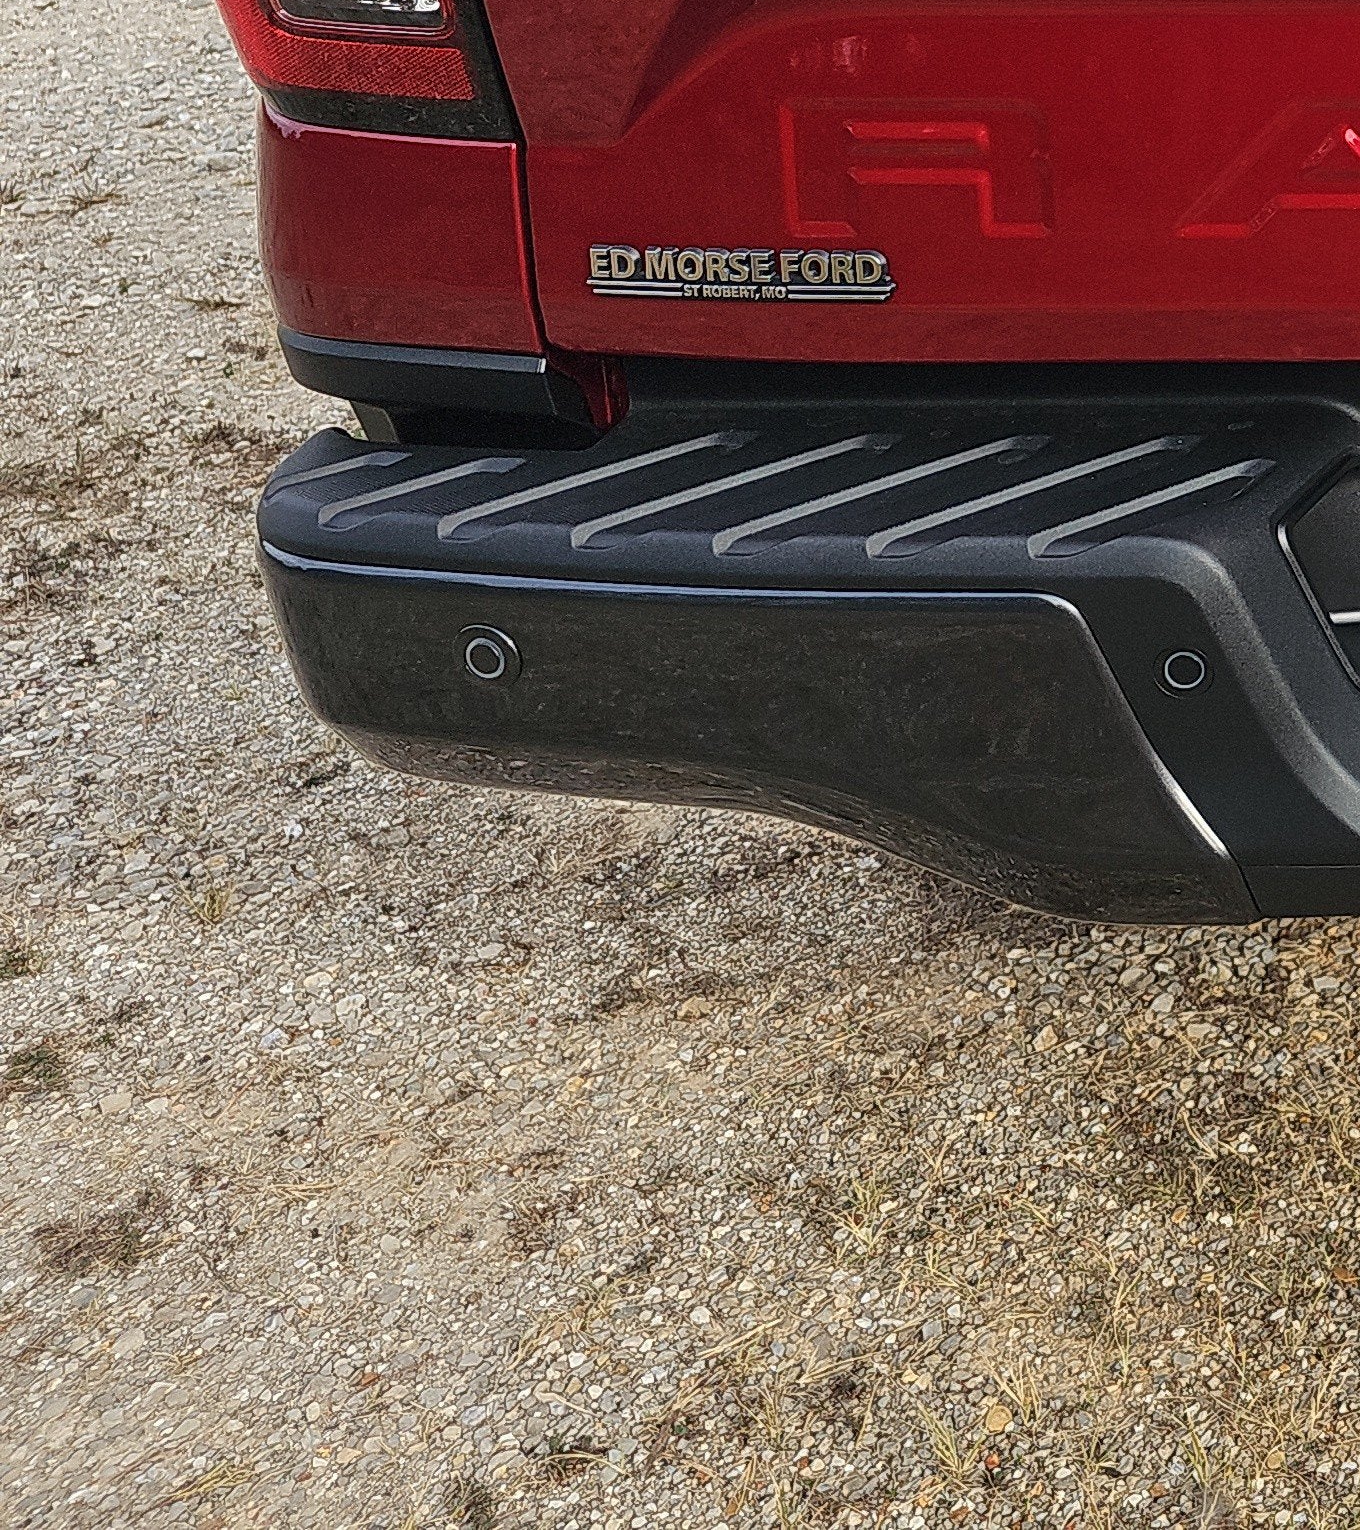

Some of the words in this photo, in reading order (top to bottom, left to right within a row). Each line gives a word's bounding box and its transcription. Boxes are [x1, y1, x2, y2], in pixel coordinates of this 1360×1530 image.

[589, 244, 639, 279] ED
[645, 245, 776, 283] MORSE
[779, 249, 888, 285] FORD
[683, 284, 701, 297] ST
[702, 285, 760, 300] ROBERT,
[761, 287, 787, 299] MO
